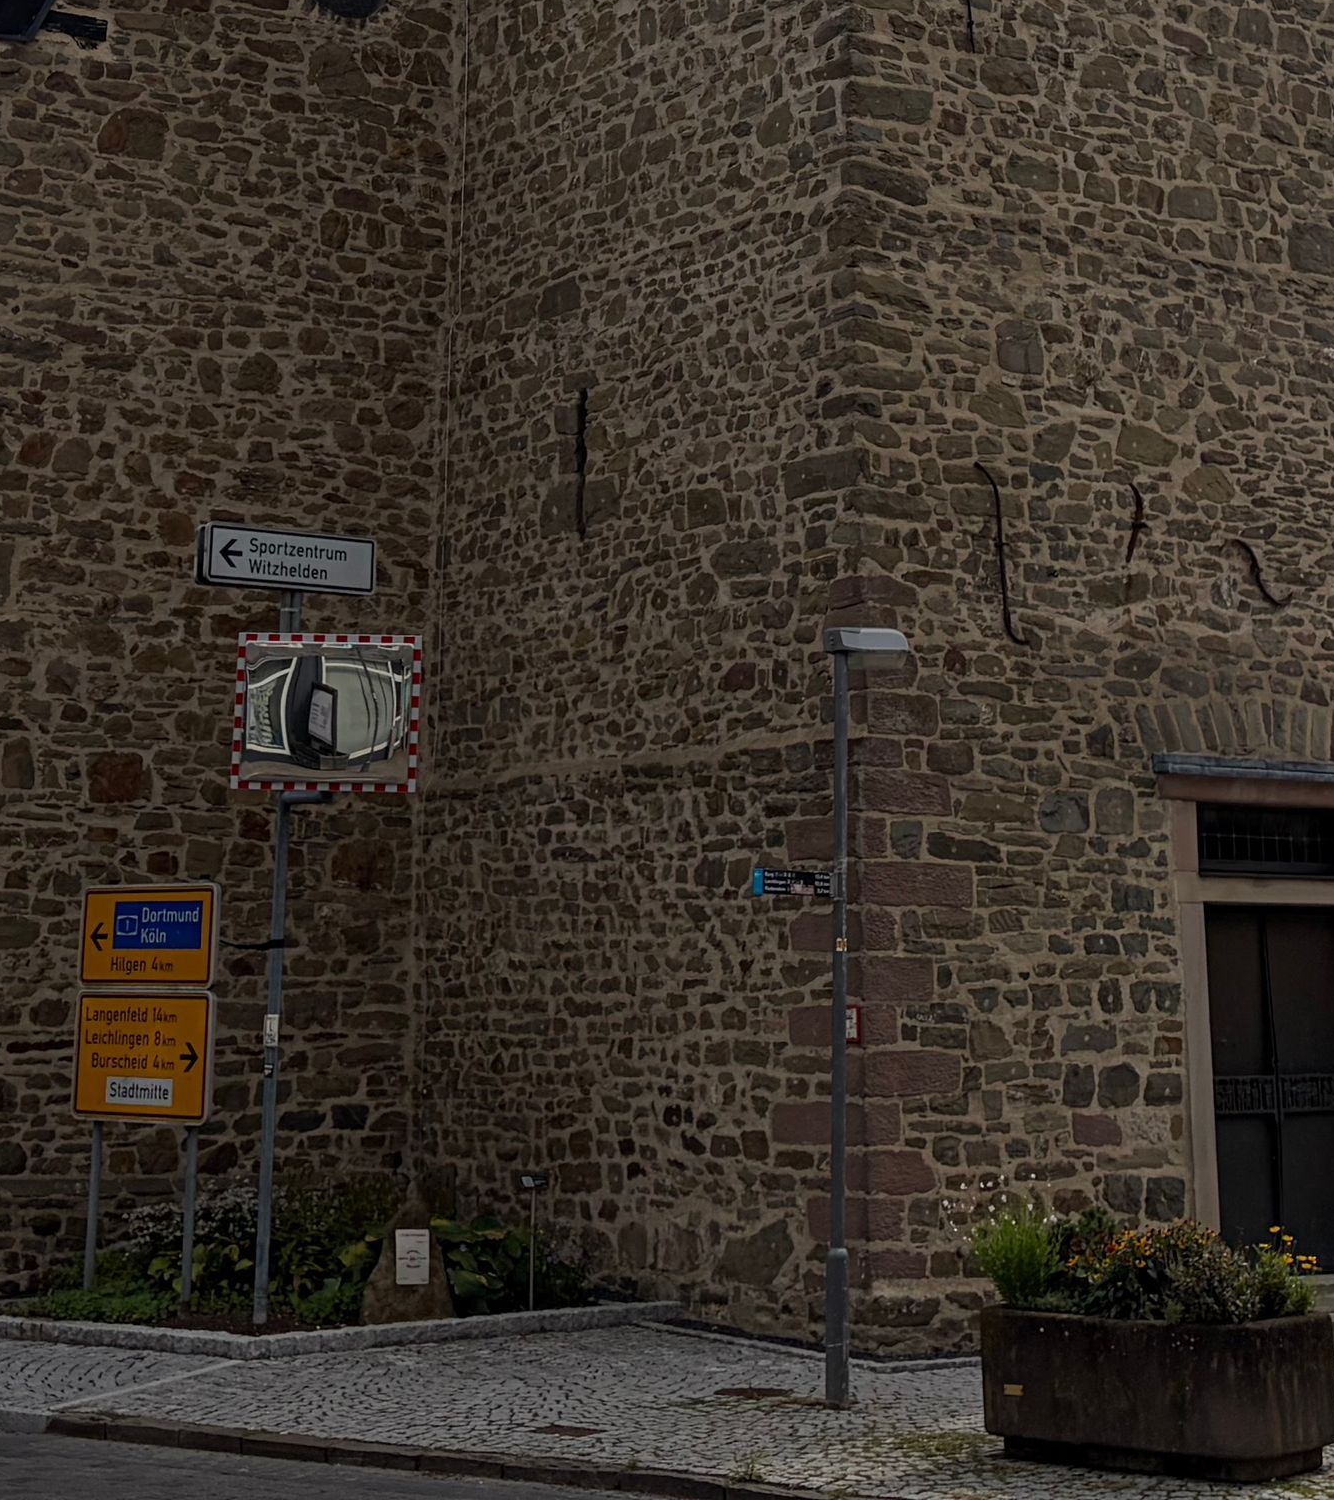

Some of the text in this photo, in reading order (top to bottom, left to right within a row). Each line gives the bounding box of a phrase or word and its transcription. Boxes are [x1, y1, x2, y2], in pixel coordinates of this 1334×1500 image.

[249, 537, 347, 562] Sportzentrum
[248, 558, 328, 580] Witzhelden
[142, 907, 200, 923] Dortmund
[140, 927, 167, 944] Köln
[110, 956, 146, 975] Hilgen
[85, 1006, 148, 1025] Langenfeld
[85, 1028, 149, 1049] Leichlingen
[91, 1052, 148, 1069] Burscheid
[109, 1081, 169, 1100] Stadtmitte
